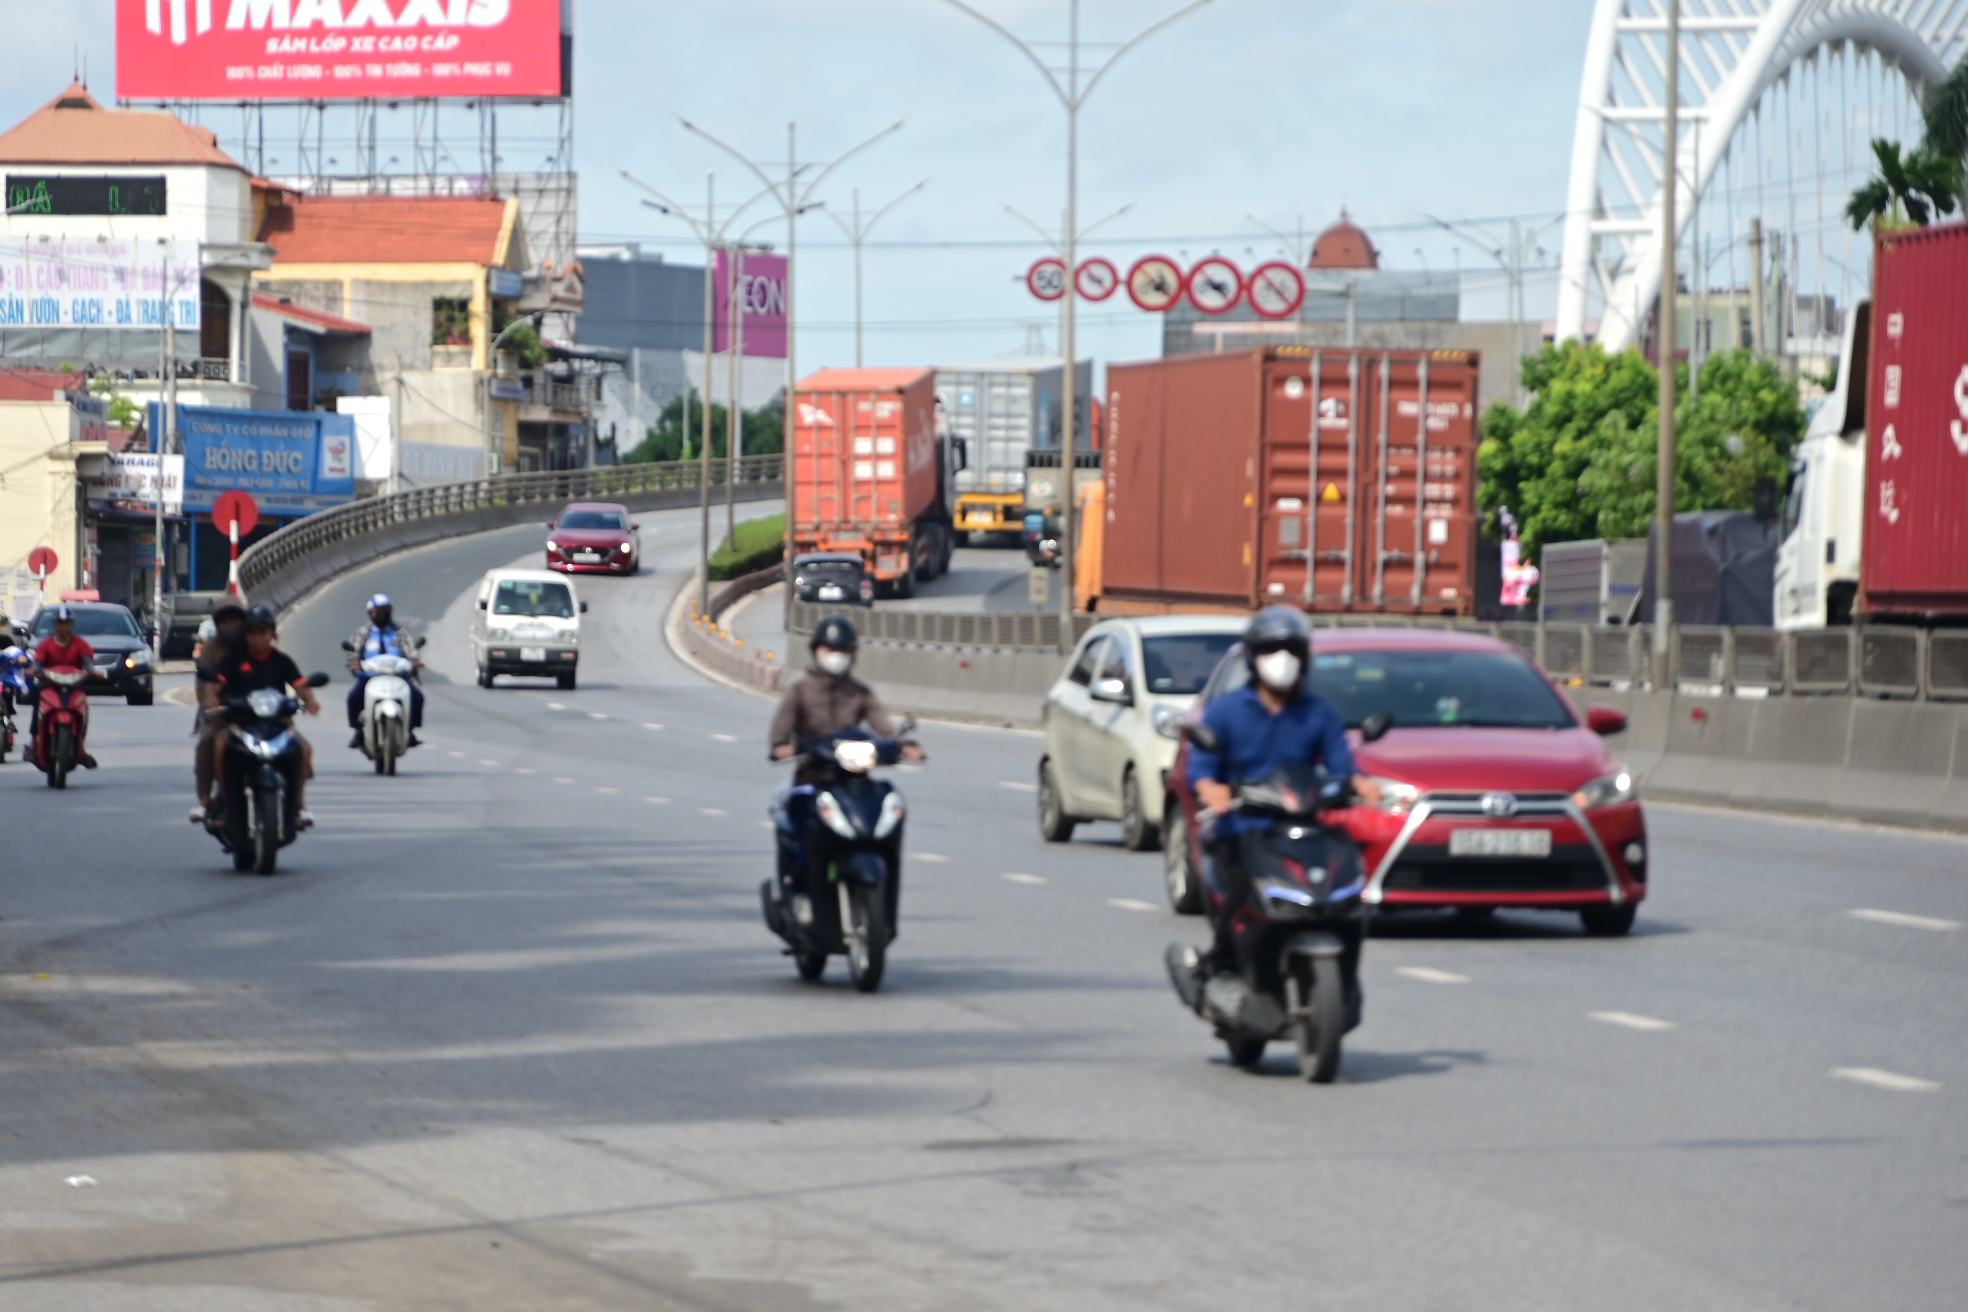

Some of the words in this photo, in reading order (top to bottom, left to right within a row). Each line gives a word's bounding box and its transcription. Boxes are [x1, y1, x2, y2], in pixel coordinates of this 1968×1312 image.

[309, 31, 347, 52] LỐP
[349, 35, 377, 52] XE
[378, 35, 419, 51] CAO
[421, 29, 460, 51] CẤP
[226, 65, 255, 80] 100%
[333, 64, 363, 79] 100%
[431, 62, 461, 78] 100%
[117, 294, 133, 324] ĐÁ
[179, 295, 197, 324] TRÍ
[226, 423, 239, 435] TY
[205, 439, 257, 472] HỒNG
[262, 444, 303, 474] ĐỨC
